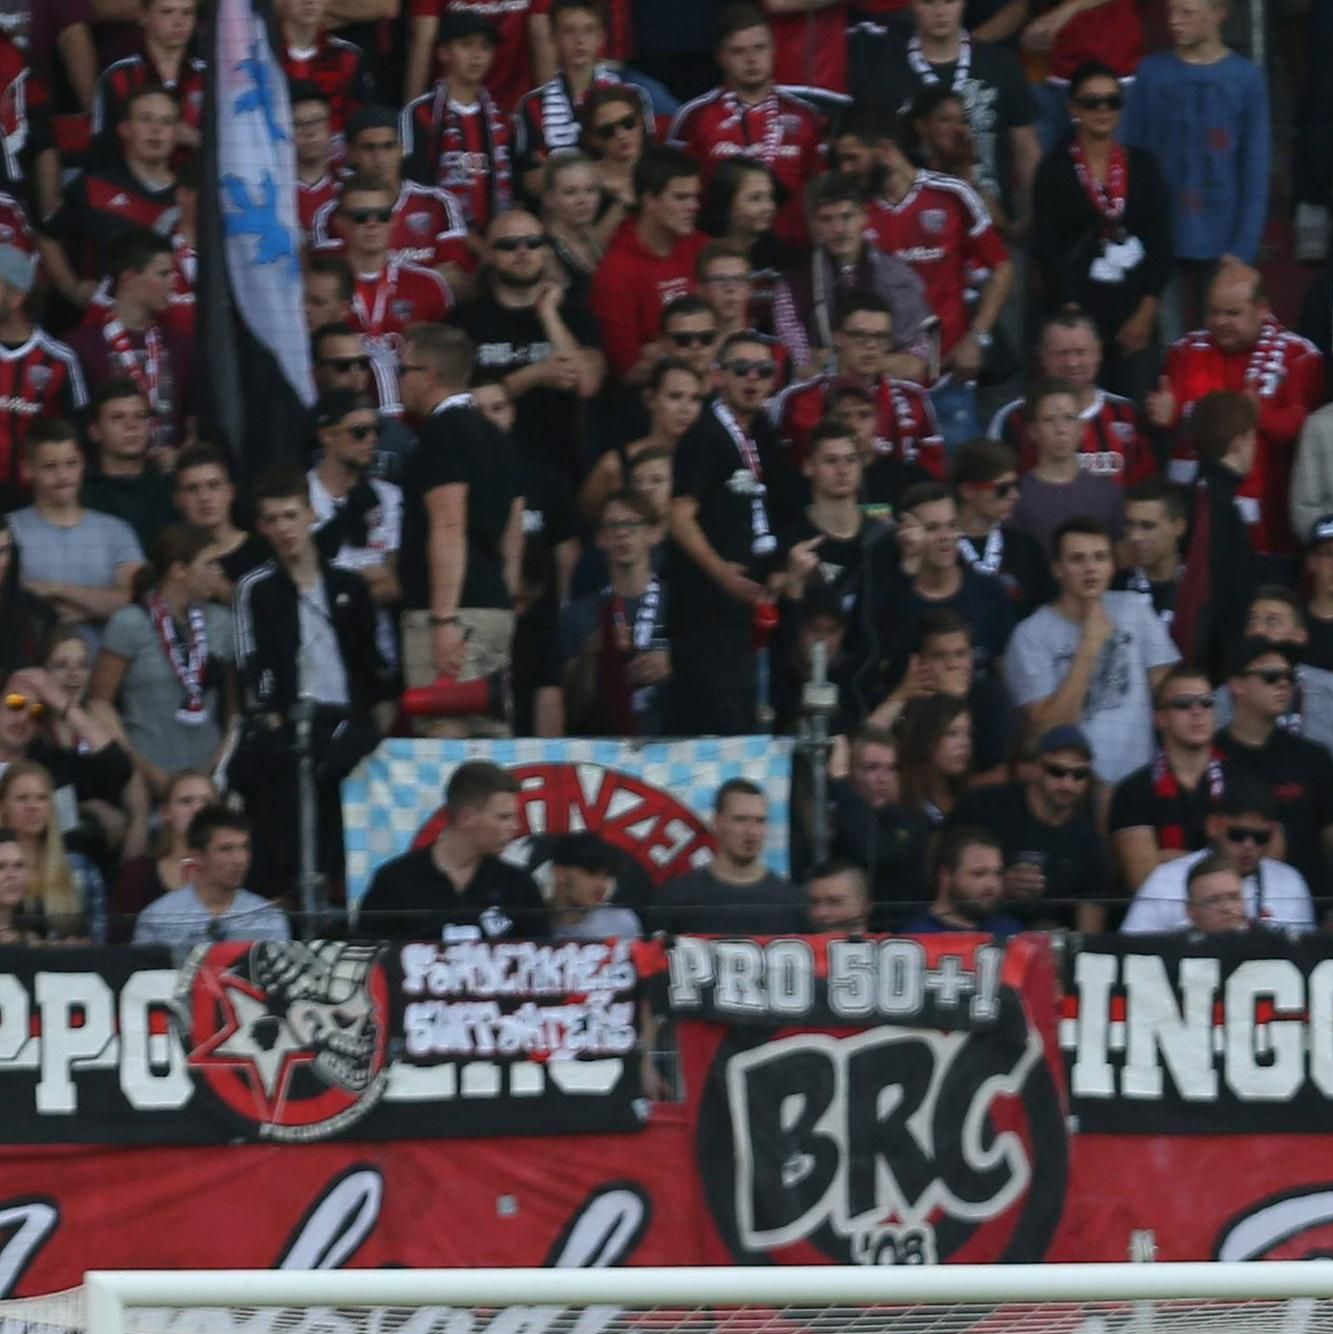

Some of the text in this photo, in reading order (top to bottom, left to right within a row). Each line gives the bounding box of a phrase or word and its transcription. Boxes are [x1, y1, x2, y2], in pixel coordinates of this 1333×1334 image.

[669, 937, 1001, 1022] PRO 50+1
[727, 1025, 1042, 1252] BRC
